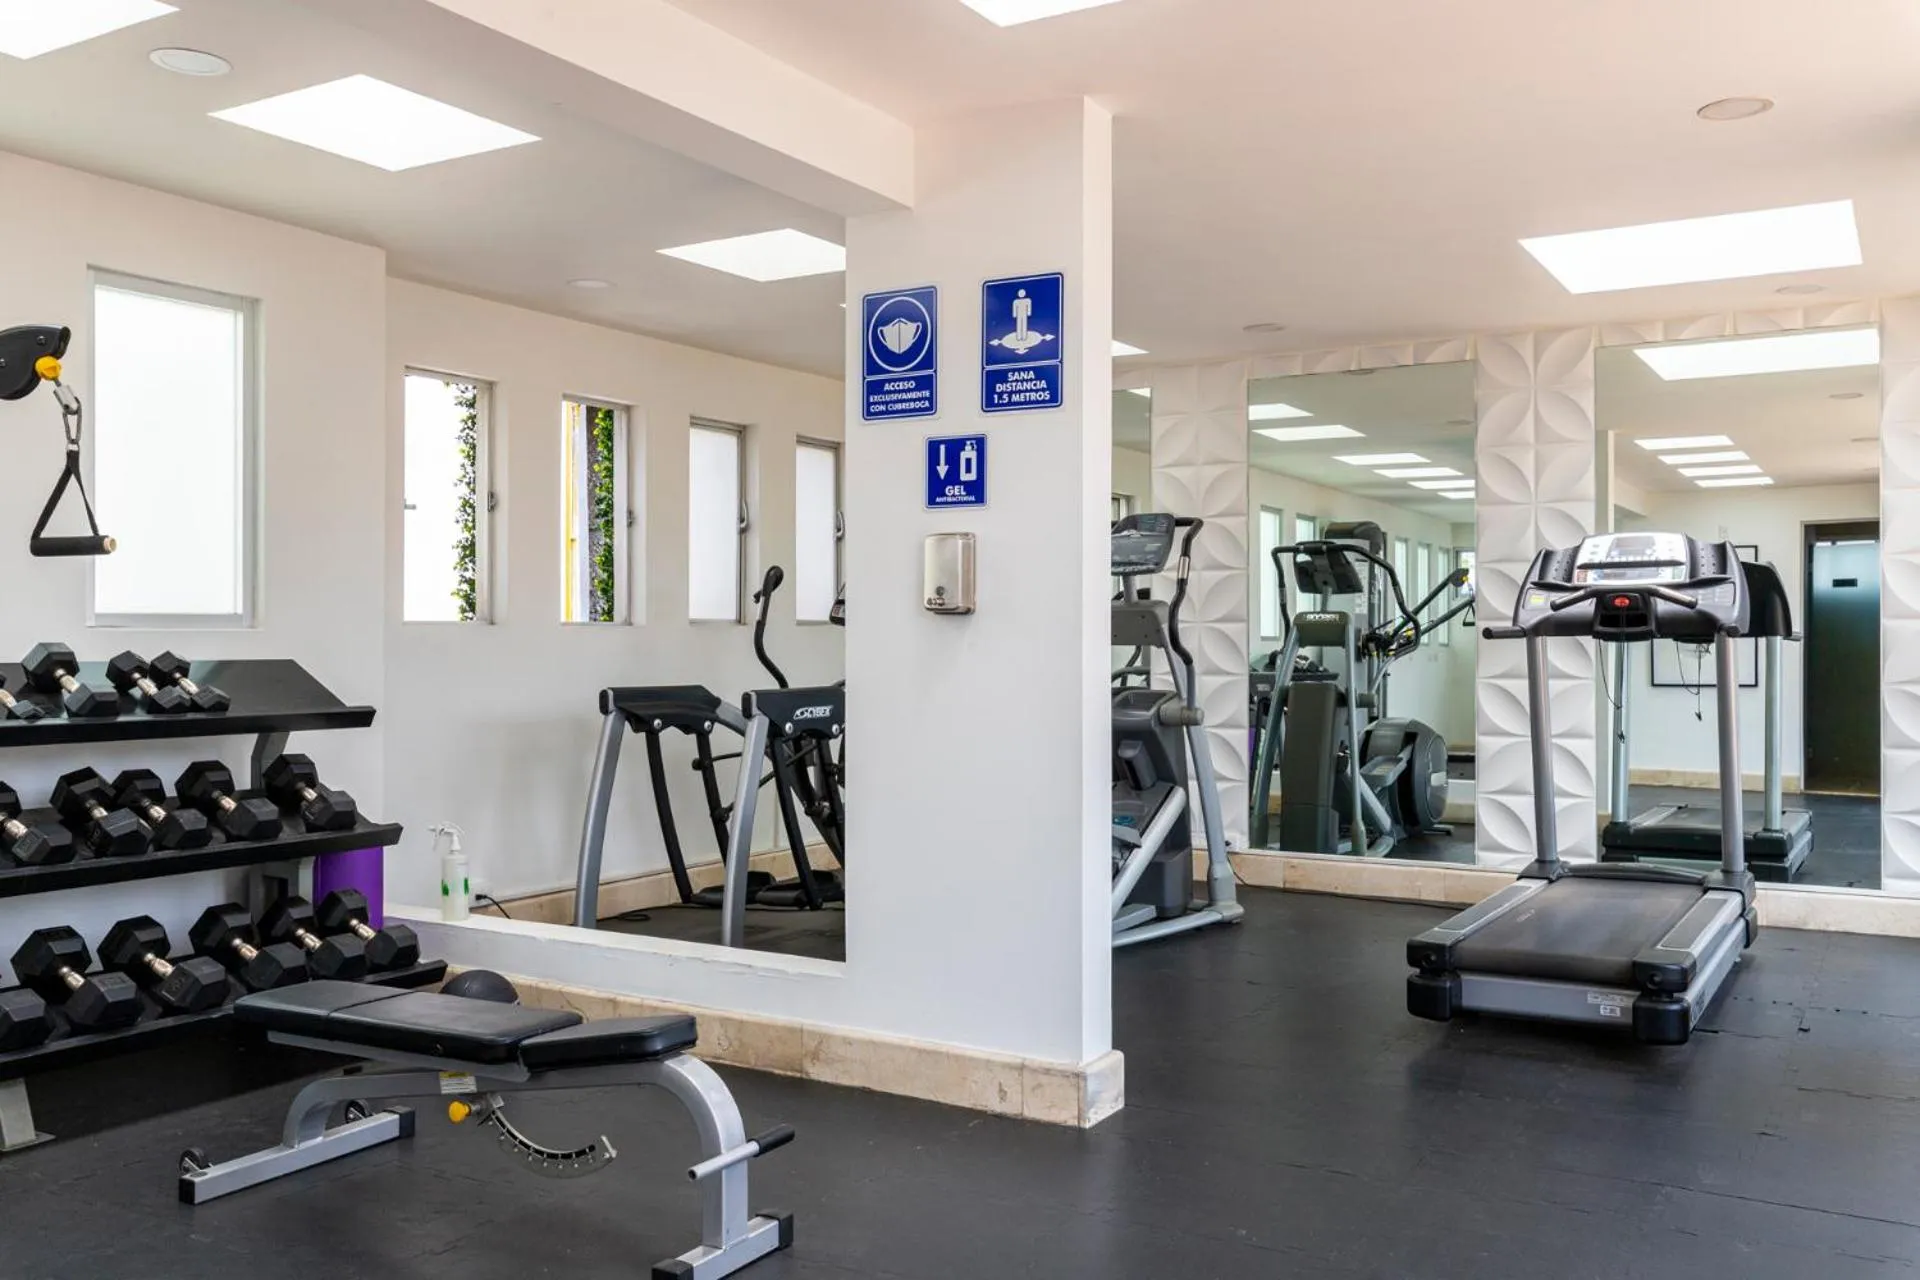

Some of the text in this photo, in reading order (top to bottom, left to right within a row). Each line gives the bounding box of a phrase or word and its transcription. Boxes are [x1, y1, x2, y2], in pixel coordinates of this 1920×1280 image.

[1008, 370, 1035, 381] SANA
[883, 380, 916, 392] ACCESO
[995, 379, 1047, 393] DISTANCIA
[869, 389, 931, 403] EXCLUSIVAMENTE
[993, 390, 1051, 404] 1.5 METROS
[869, 400, 930, 413] CON CUBREBOCA
[945, 485, 967, 496] GEL
